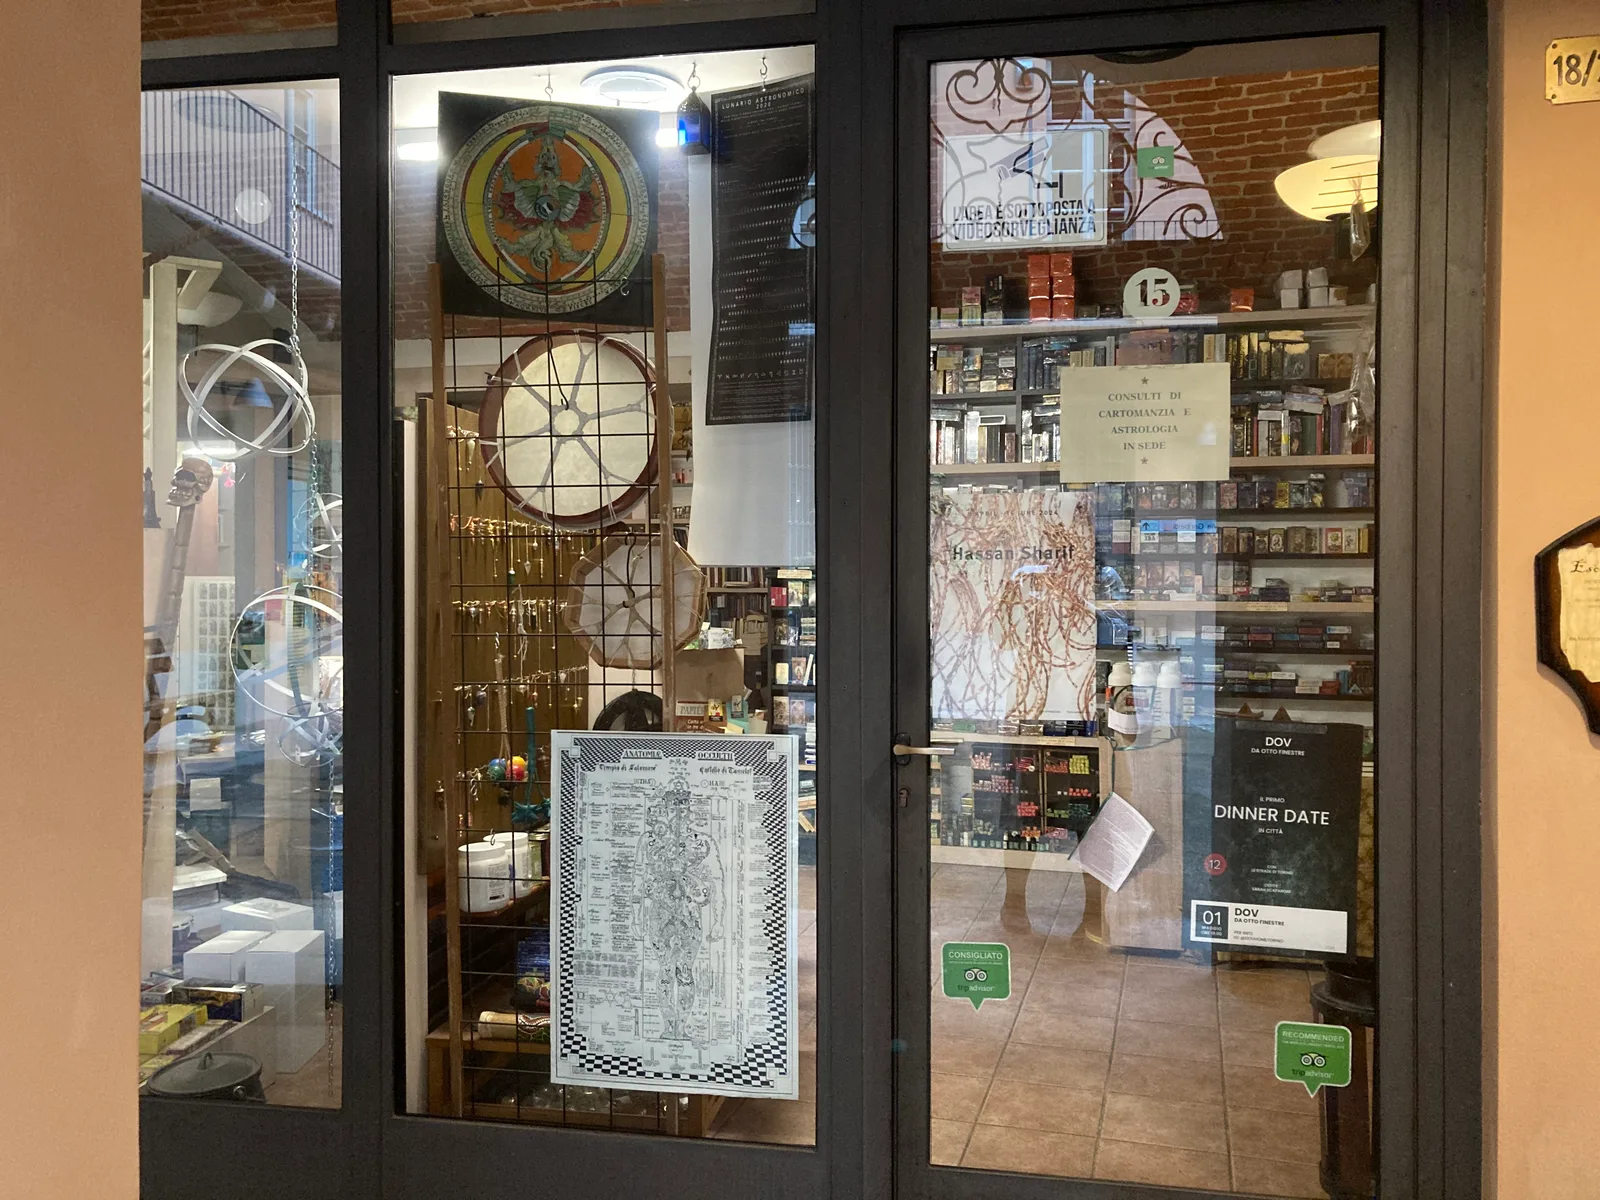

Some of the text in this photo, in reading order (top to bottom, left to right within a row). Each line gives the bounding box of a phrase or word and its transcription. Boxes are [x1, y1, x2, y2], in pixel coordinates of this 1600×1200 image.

[1553, 49, 1600, 87] 18/
[721, 87, 805, 110] LUNARIO ASTRONOMICO
[953, 205, 993, 221] L'AREA
[1006, 200, 1084, 219] SOTTOPOSTA
[1087, 199, 1096, 215] A
[952, 216, 1097, 240] VIDEOSORVEGLIANZA
[1135, 277, 1170, 306] 15
[1108, 391, 1181, 401] CONSULTI DI
[1098, 407, 1192, 418] CARTOMANZIA E
[1111, 425, 1179, 434] ASTROLOGIA
[1123, 441, 1166, 450] IN SEDE
[953, 545, 1075, 560] Hassan Sharif
[1265, 736, 1292, 748] DOV
[1278, 749, 1305, 757] FINESTRE
[1214, 804, 1330, 826] DINNER DATE
[1265, 827, 1284, 835] CITTÀ
[1208, 859, 1221, 870] 12
[1202, 910, 1221, 926] 01
[1234, 907, 1259, 918] DOV
[948, 951, 1003, 960] CONSIGLIATO
[957, 984, 994, 992] tripadvisor
[1282, 1031, 1345, 1042] RECOMMENDED
[1292, 1069, 1332, 1078] tripadvisor
